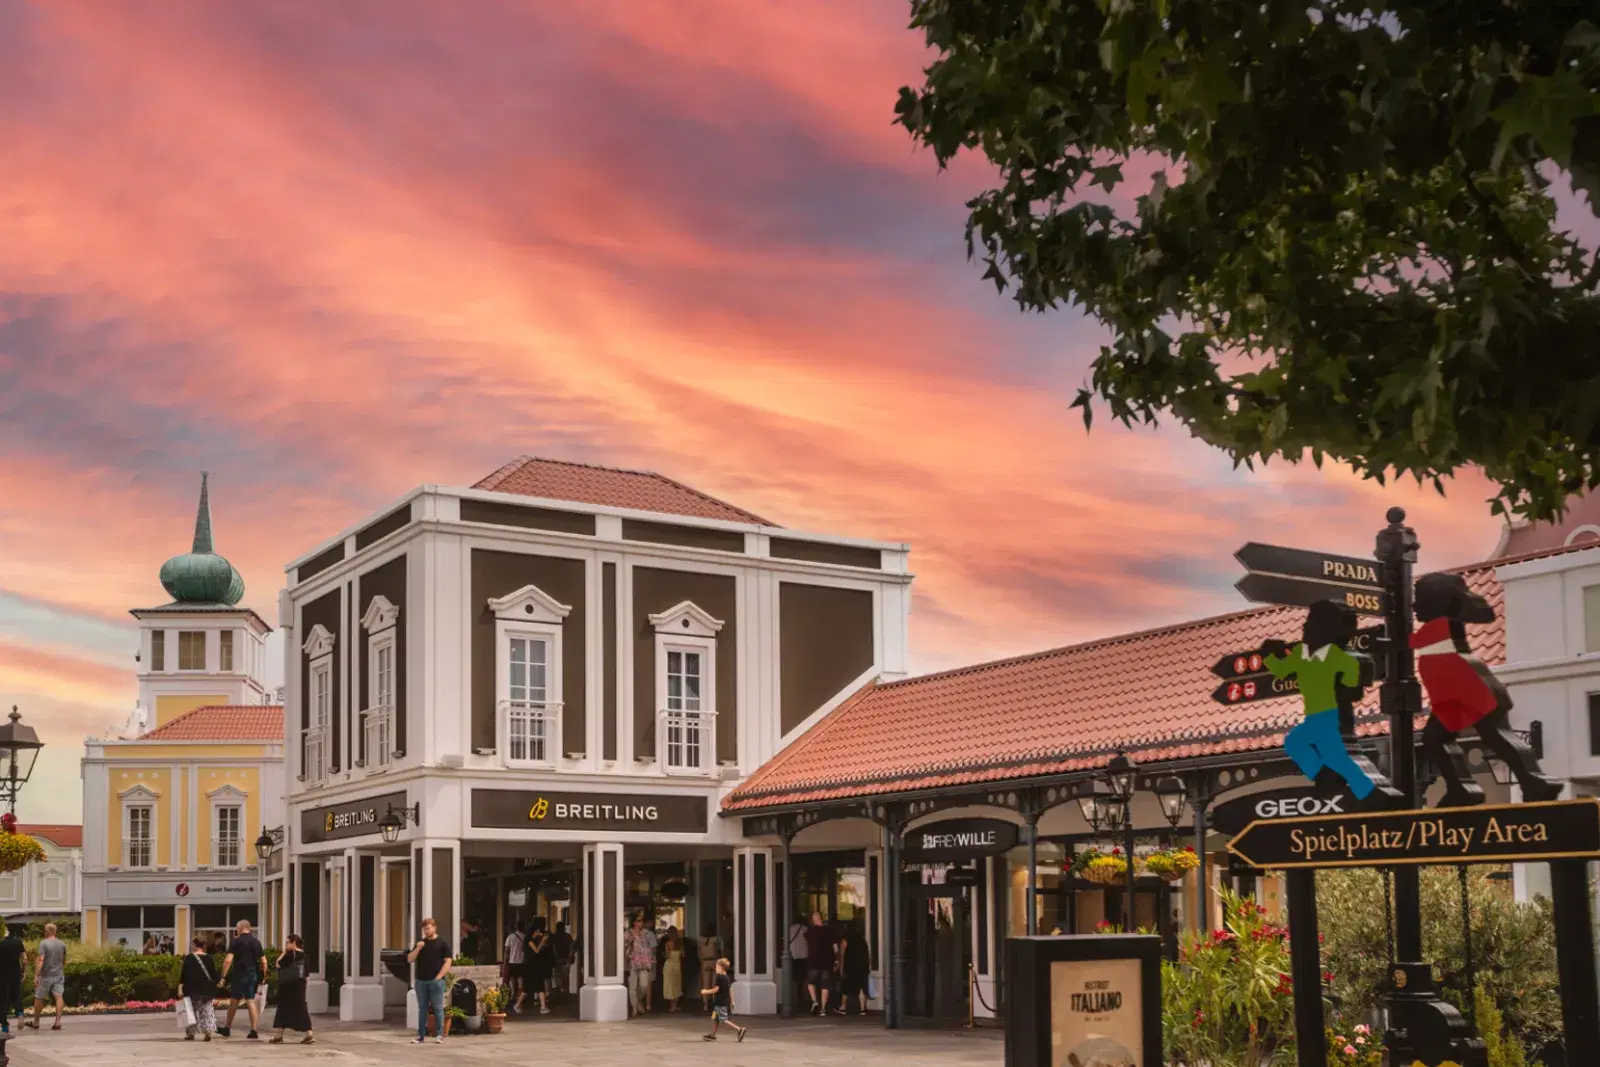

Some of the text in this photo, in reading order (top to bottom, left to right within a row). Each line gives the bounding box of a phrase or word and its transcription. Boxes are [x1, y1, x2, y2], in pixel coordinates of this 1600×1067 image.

[1322, 560, 1378, 582] PRADA
[1345, 592, 1380, 610] BOSS
[555, 803, 659, 820] BREITLING
[1254, 794, 1345, 818] GEOX
[334, 809, 375, 828] BREITLING
[933, 831, 997, 849] FREYWILLE
[1290, 816, 1548, 860] Spielplatz/Play Area
[1070, 990, 1123, 1013] ITALIANO
